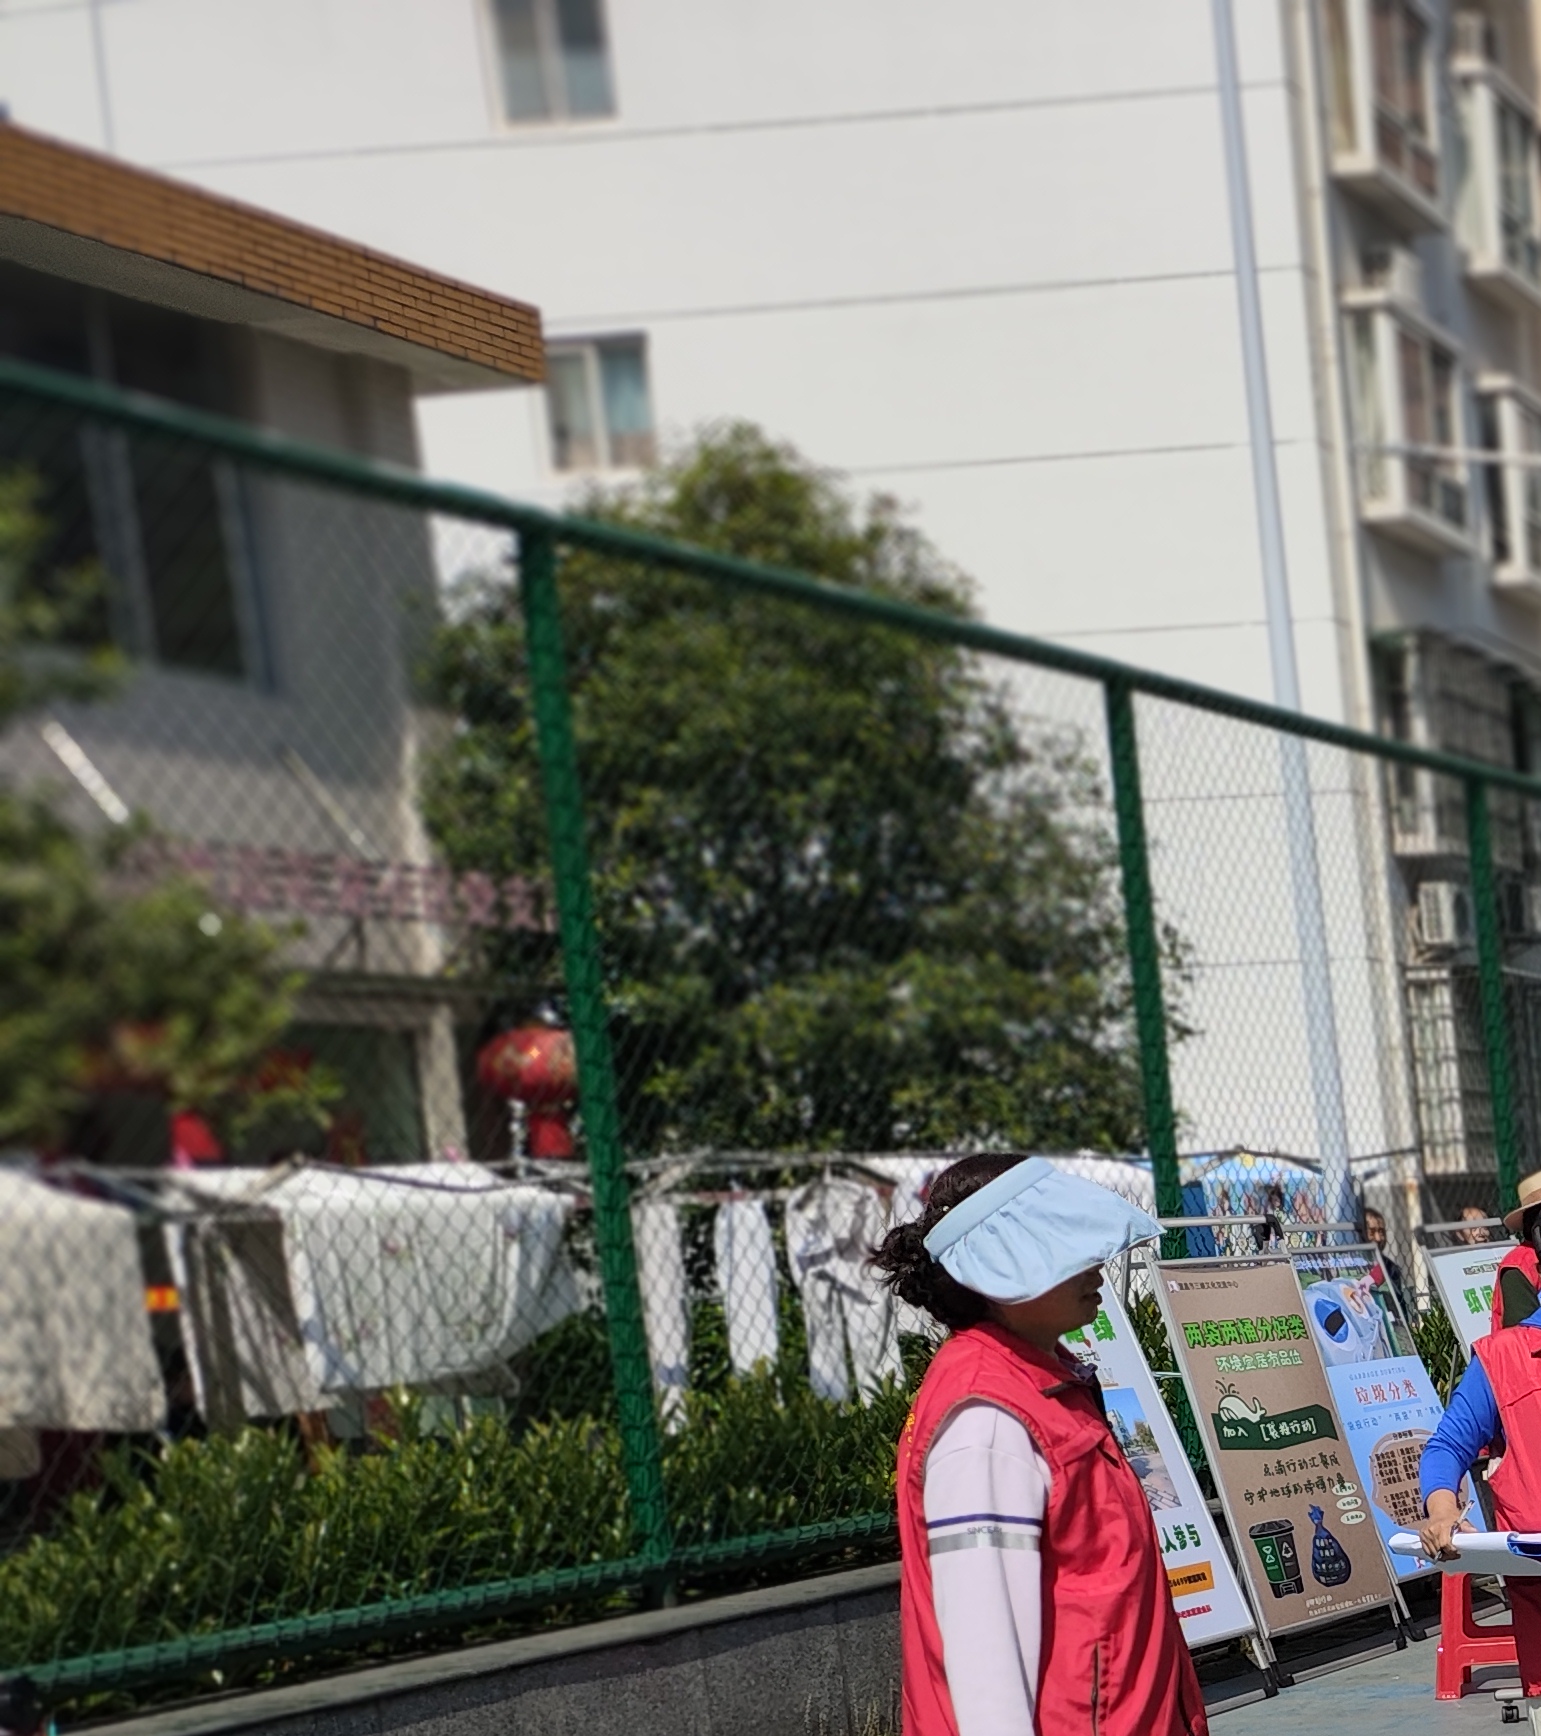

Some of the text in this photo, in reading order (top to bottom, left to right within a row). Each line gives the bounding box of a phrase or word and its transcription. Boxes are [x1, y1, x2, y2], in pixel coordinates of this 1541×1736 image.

[1182, 1314, 1310, 1349] 两袋两桶分好类
[1215, 1349, 1304, 1374] 环境宜居有品位
[1354, 1379, 1418, 1406] 垃圾分类
[1223, 1425, 1249, 1438] 加入
[1160, 1523, 1202, 1554] 人参与
